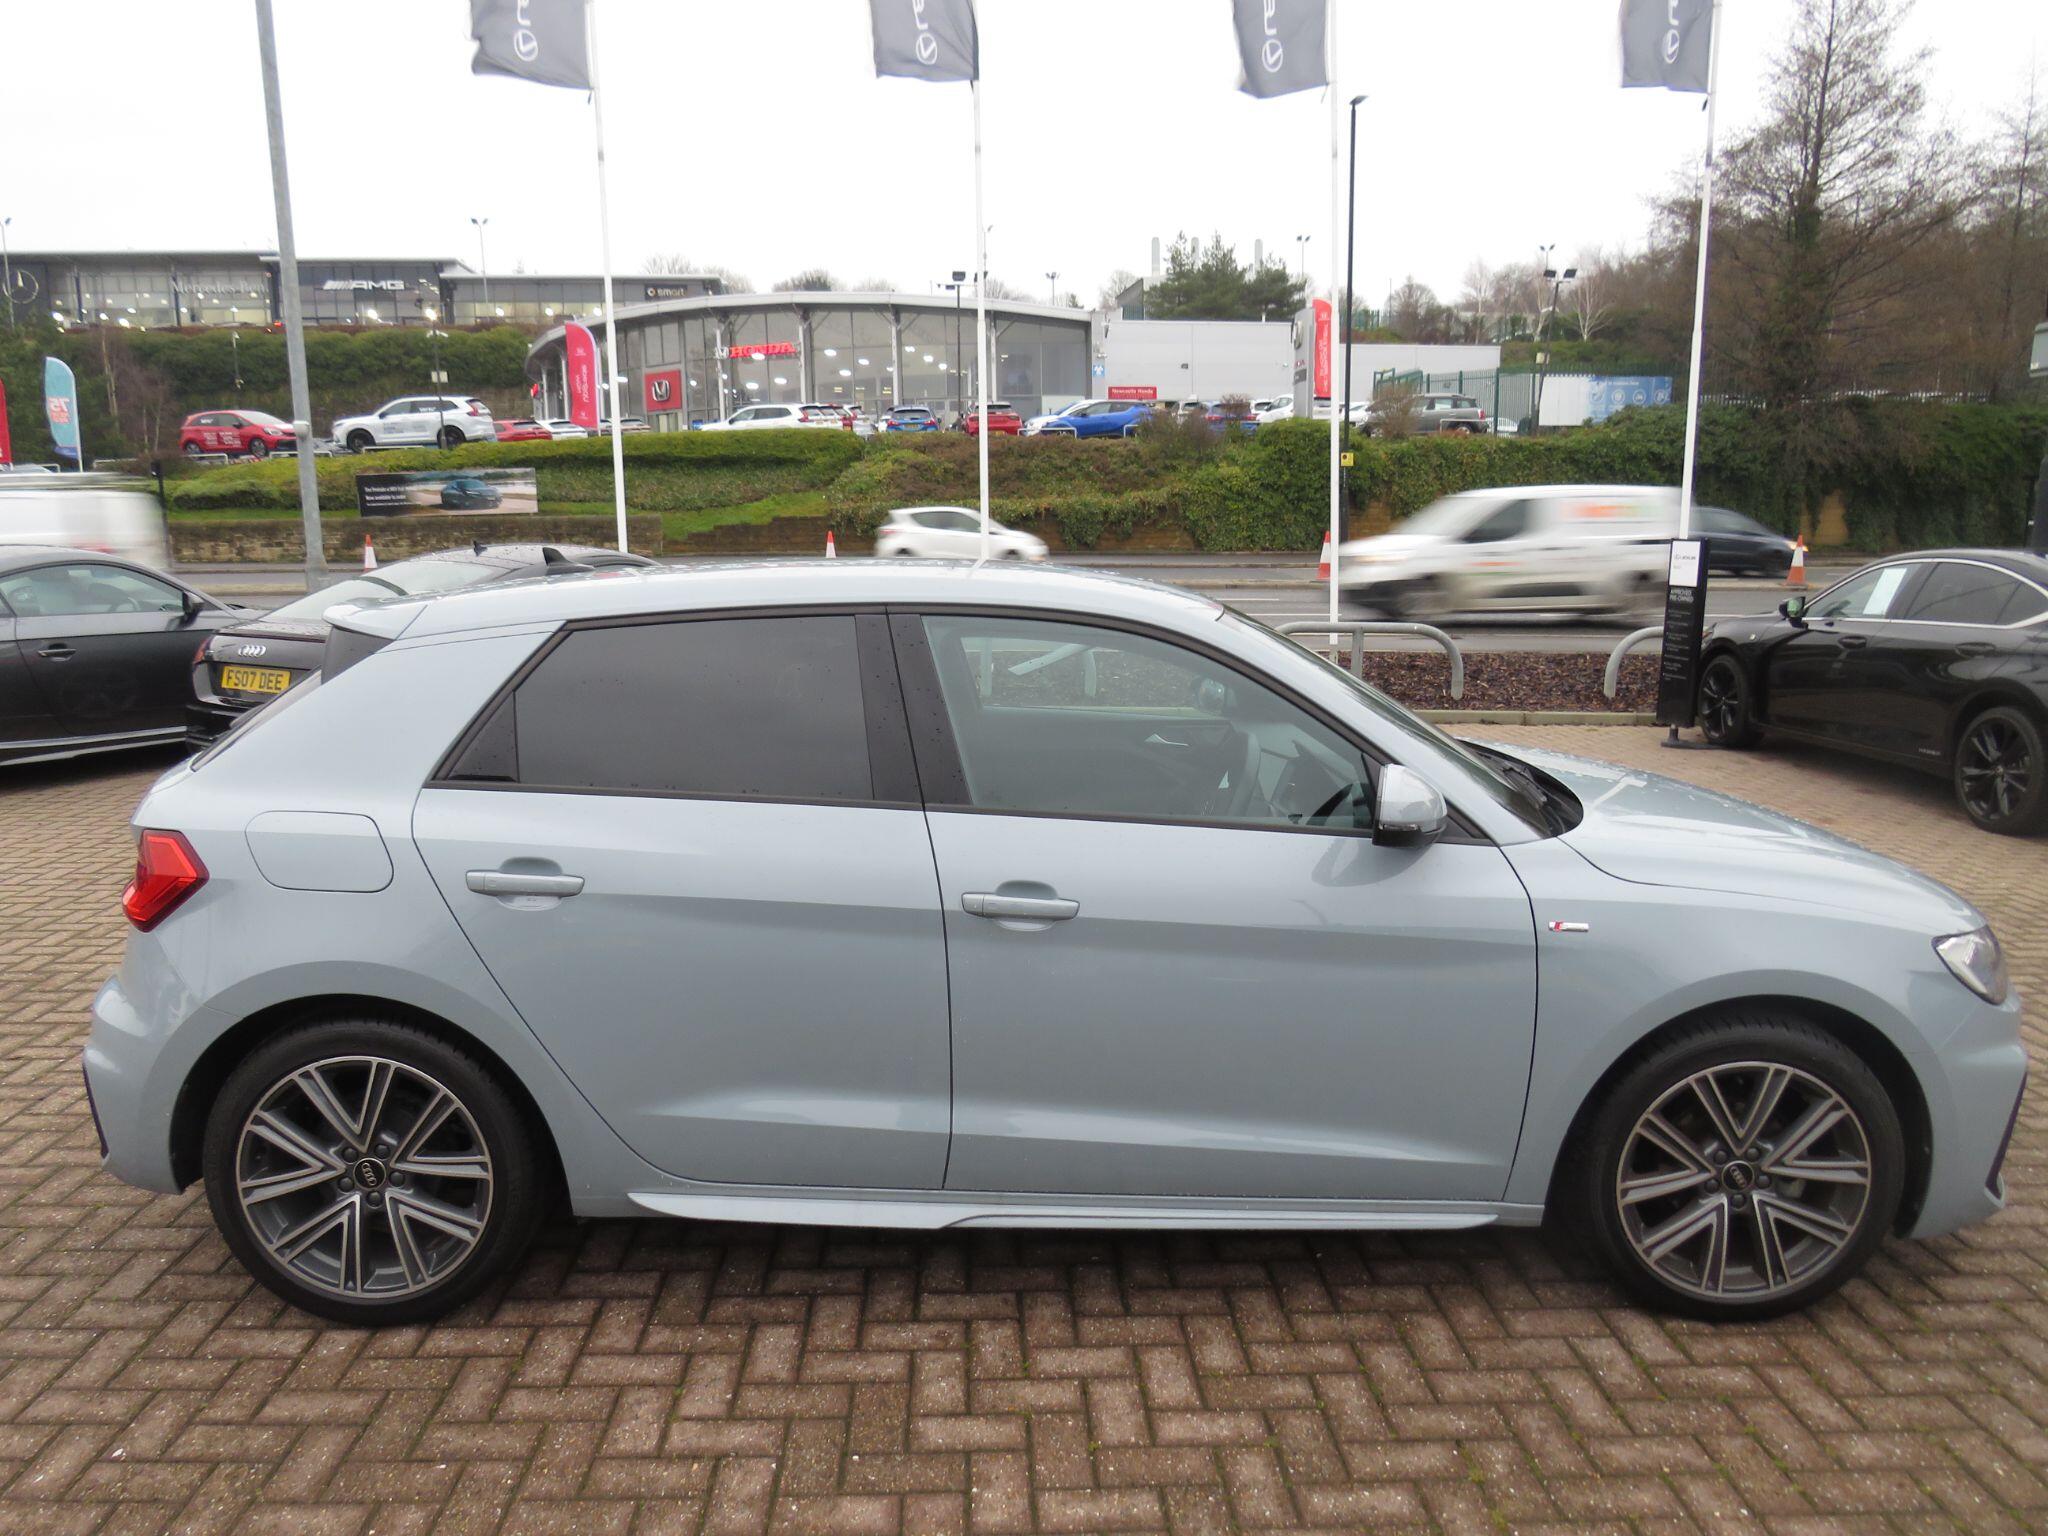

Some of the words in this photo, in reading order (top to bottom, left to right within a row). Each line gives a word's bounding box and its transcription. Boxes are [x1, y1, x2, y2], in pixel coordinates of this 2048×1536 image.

[351, 280, 405, 290] AMG
[658, 288, 687, 297] smart
[730, 342, 796, 357] HONDA
[227, 669, 257, 688] FS07
[259, 672, 283, 690] DEE
